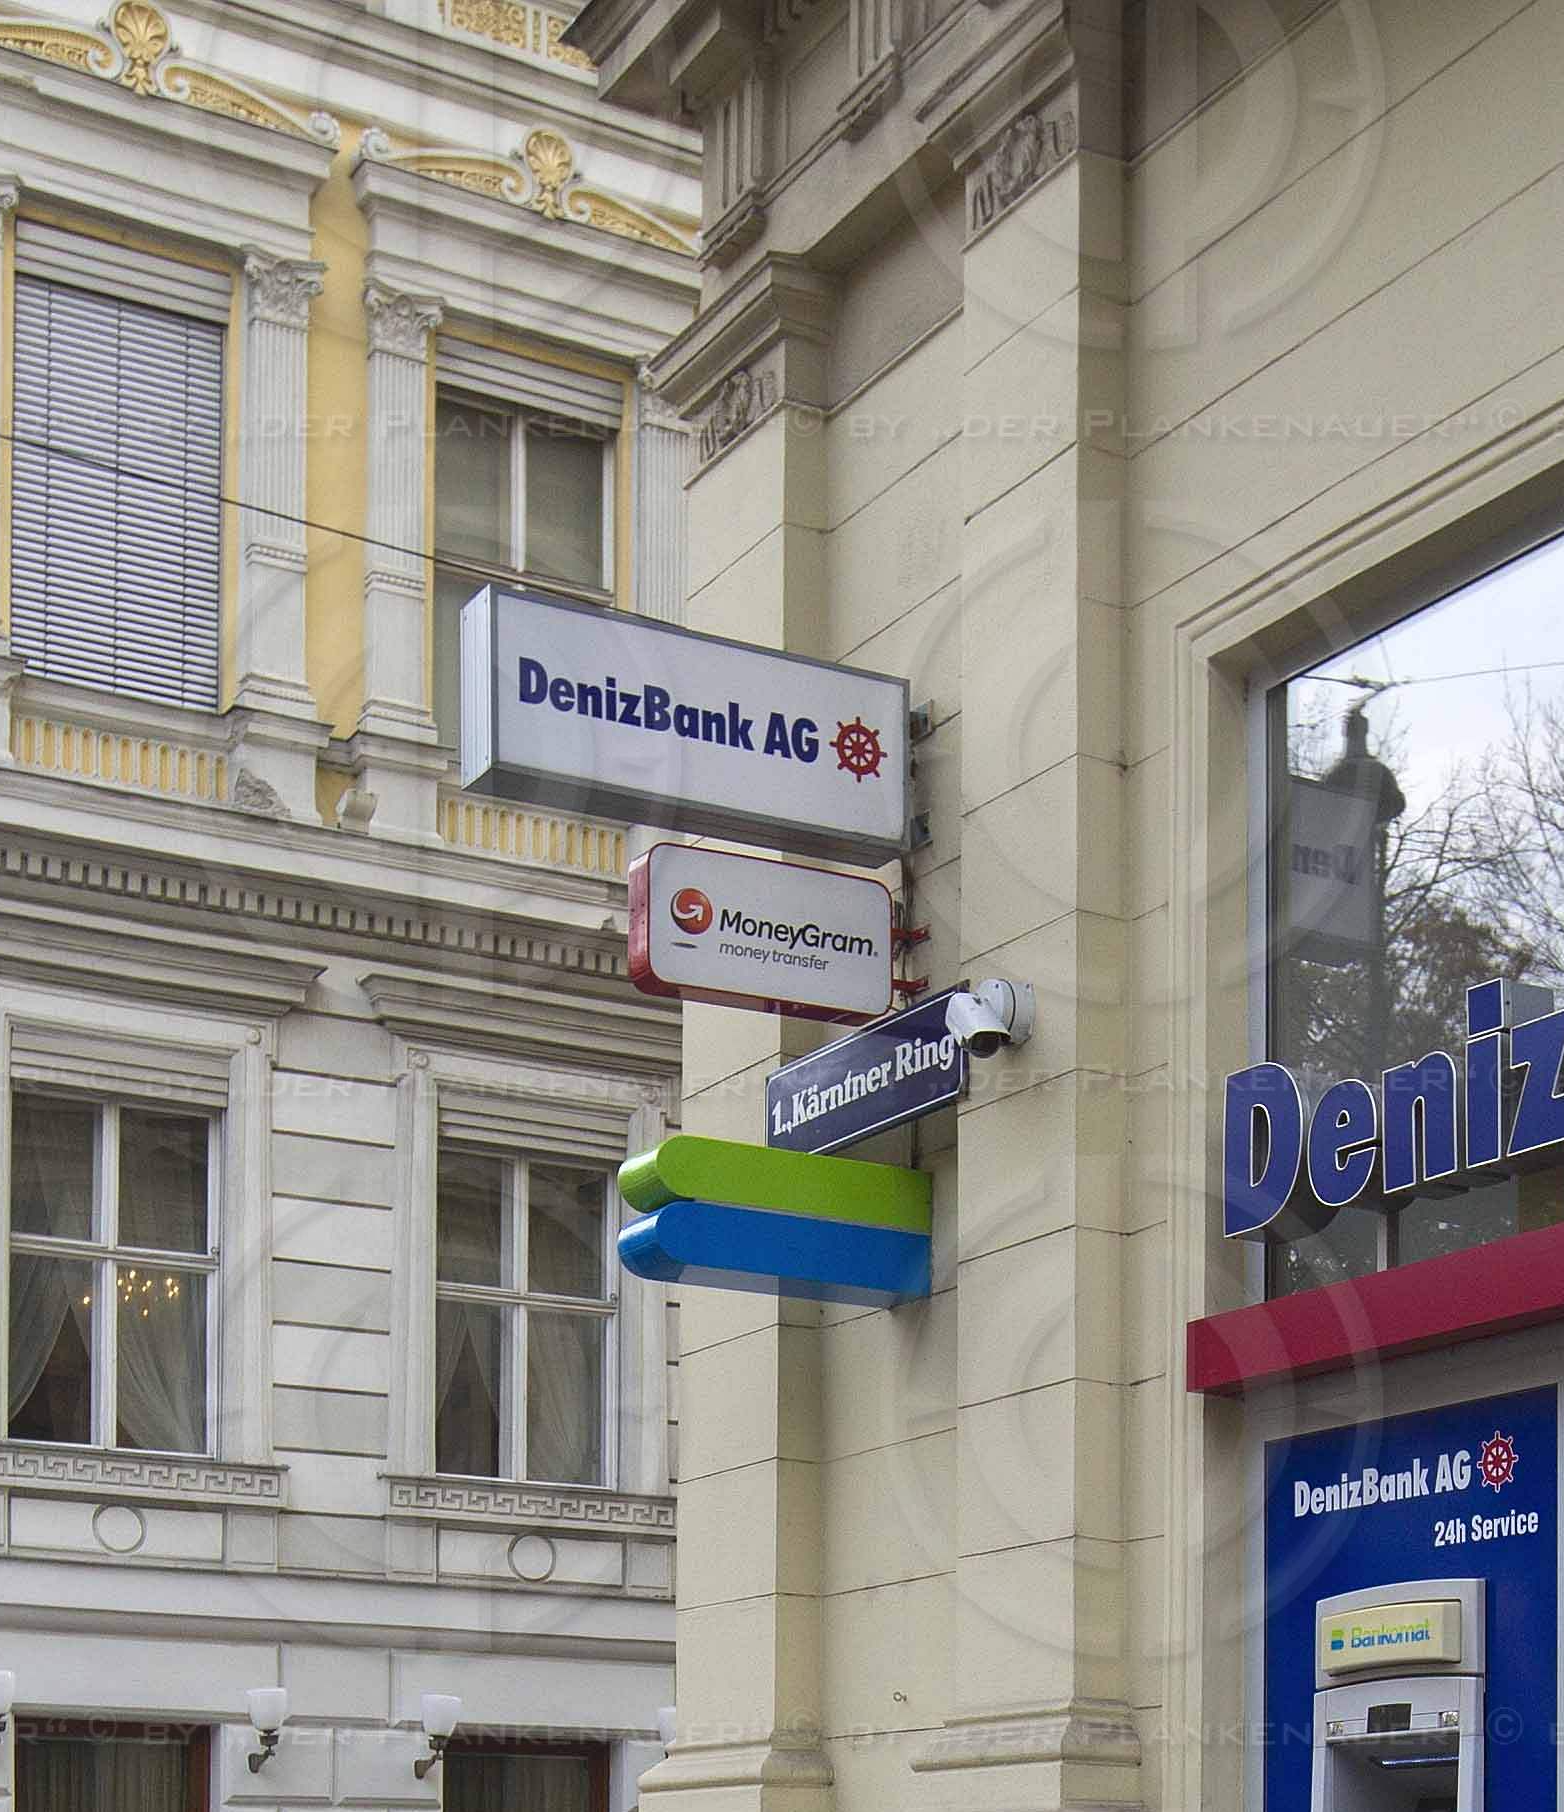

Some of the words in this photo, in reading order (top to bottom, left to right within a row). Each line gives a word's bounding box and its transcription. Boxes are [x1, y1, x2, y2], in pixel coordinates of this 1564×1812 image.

[518, 656, 754, 753] DenizBank
[763, 711, 820, 763] AG
[719, 907, 874, 957] MoneyGram
[718, 941, 768, 964] money
[770, 948, 830, 971] transfer
[894, 1034, 956, 1081] Ring
[1294, 1458, 1430, 1518] DenizBank
[1434, 1449, 1472, 1494] AG
[1434, 1517, 1466, 1547] 24h
[1471, 1509, 1539, 1542] Service
[1350, 1617, 1431, 1649] Bankomat
